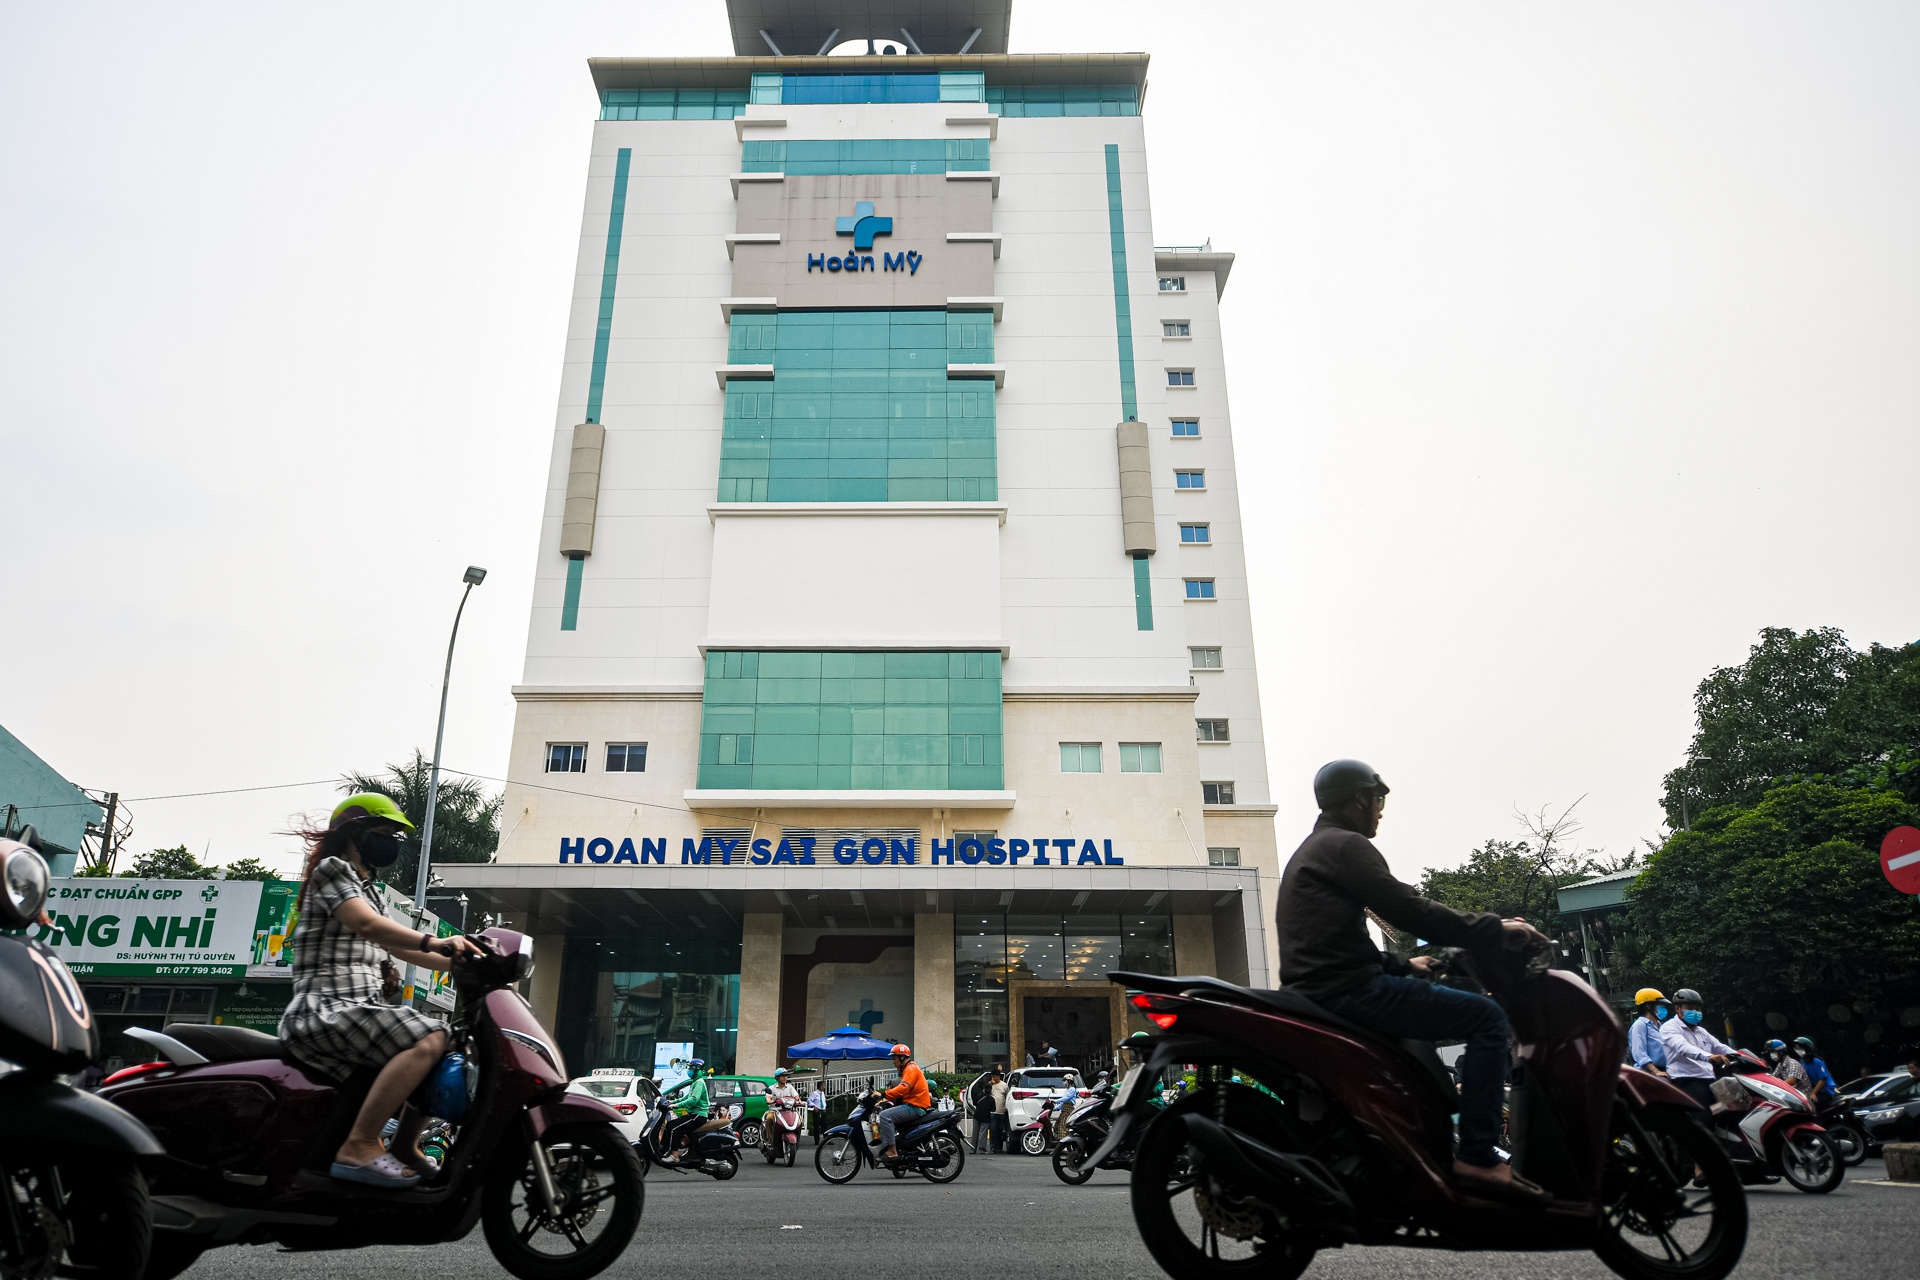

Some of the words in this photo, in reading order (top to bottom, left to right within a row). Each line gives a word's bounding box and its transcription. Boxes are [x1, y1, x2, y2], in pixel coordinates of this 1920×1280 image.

[807, 249, 875, 273] Hoàn
[883, 249, 923, 276] Mỹ
[559, 837, 666, 864] HOAN
[681, 838, 741, 865] MY
[748, 838, 817, 865] SAI
[833, 838, 915, 865] GON
[931, 837, 1124, 865] HOSPITAL
[60, 887, 92, 901] ĐẠT
[95, 883, 150, 900] CHUẨN
[152, 889, 183, 900] GPP
[116, 952, 132, 960] DS:
[134, 951, 168, 960] HUỲNH
[170, 953, 186, 962] THỊ
[188, 951, 201, 960] TÚ
[203, 952, 236, 961] QUYÊN
[66, 964, 94, 974] HUẬN
[155, 966, 171, 974] ĐT:
[173, 966, 190, 974] 077
[210, 967, 233, 975] 3402
